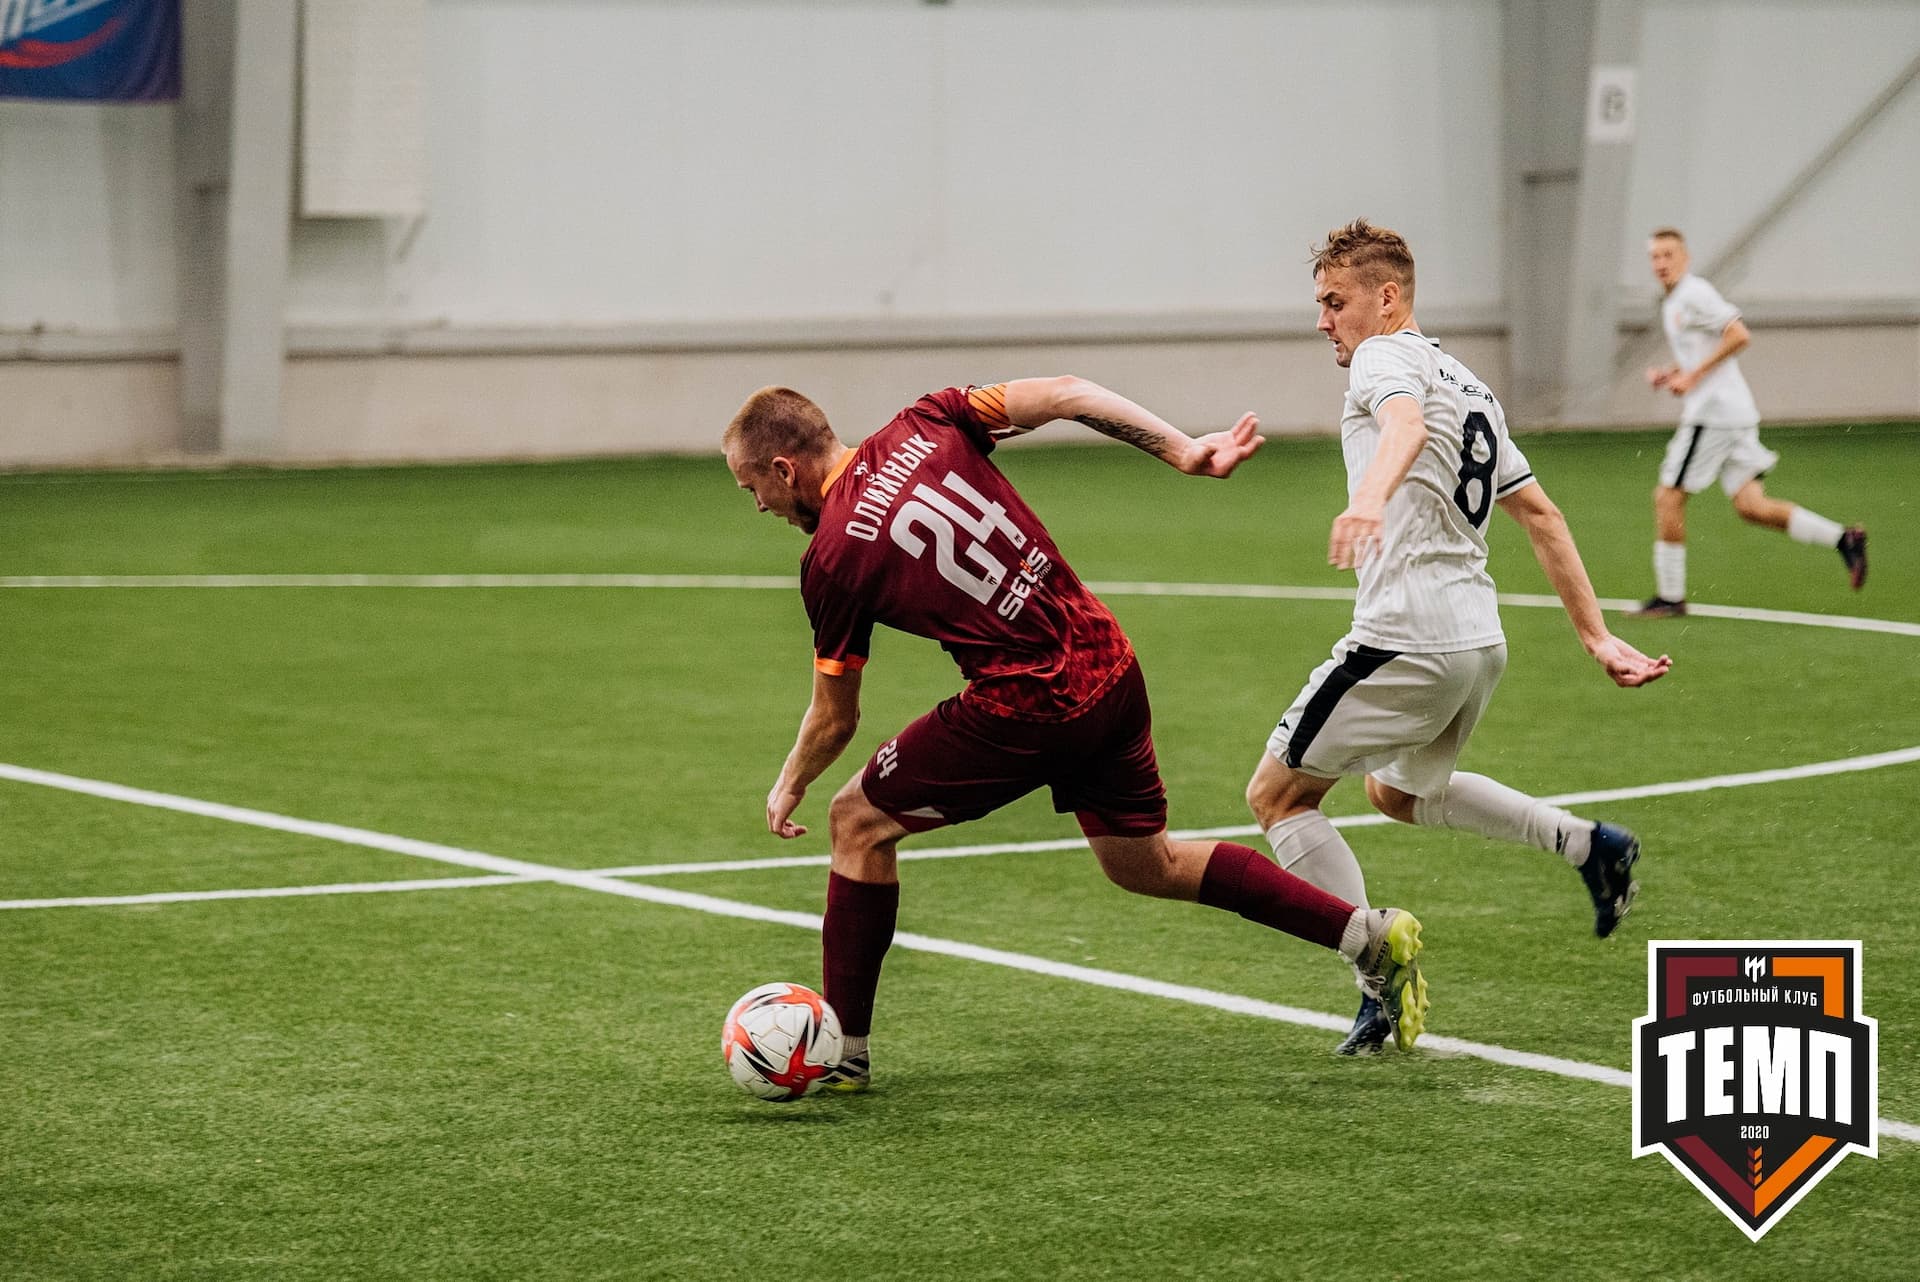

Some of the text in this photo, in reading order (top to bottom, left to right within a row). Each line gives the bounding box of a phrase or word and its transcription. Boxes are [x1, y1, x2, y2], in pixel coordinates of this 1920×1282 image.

[845, 434, 938, 541] ОЛИЙНЫК
[1454, 412, 1497, 529] 8
[889, 471, 1028, 605] 24
[876, 738, 898, 780] 24
